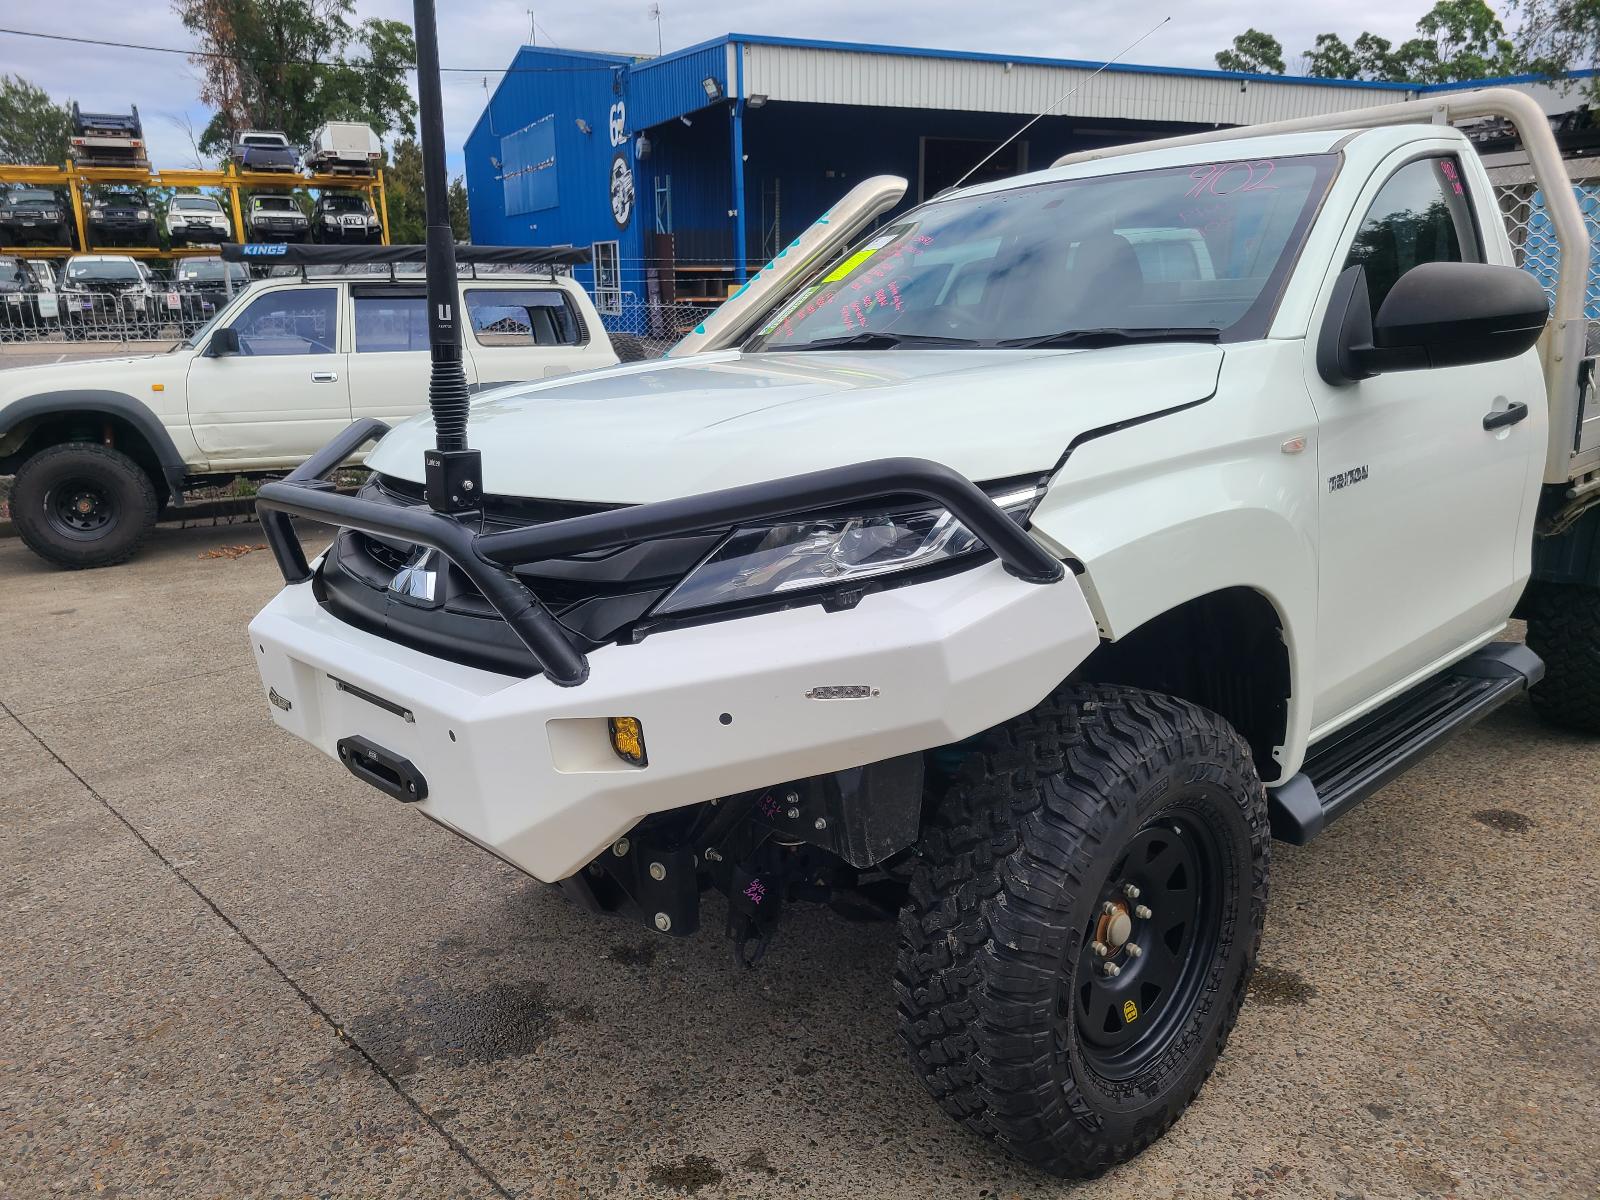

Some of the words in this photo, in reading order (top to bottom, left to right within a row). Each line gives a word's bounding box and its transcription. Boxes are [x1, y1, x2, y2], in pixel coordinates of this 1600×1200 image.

[609, 101, 627, 148] 62
[243, 245, 287, 255] KINGS
[1328, 464, 1369, 493] TRITON
